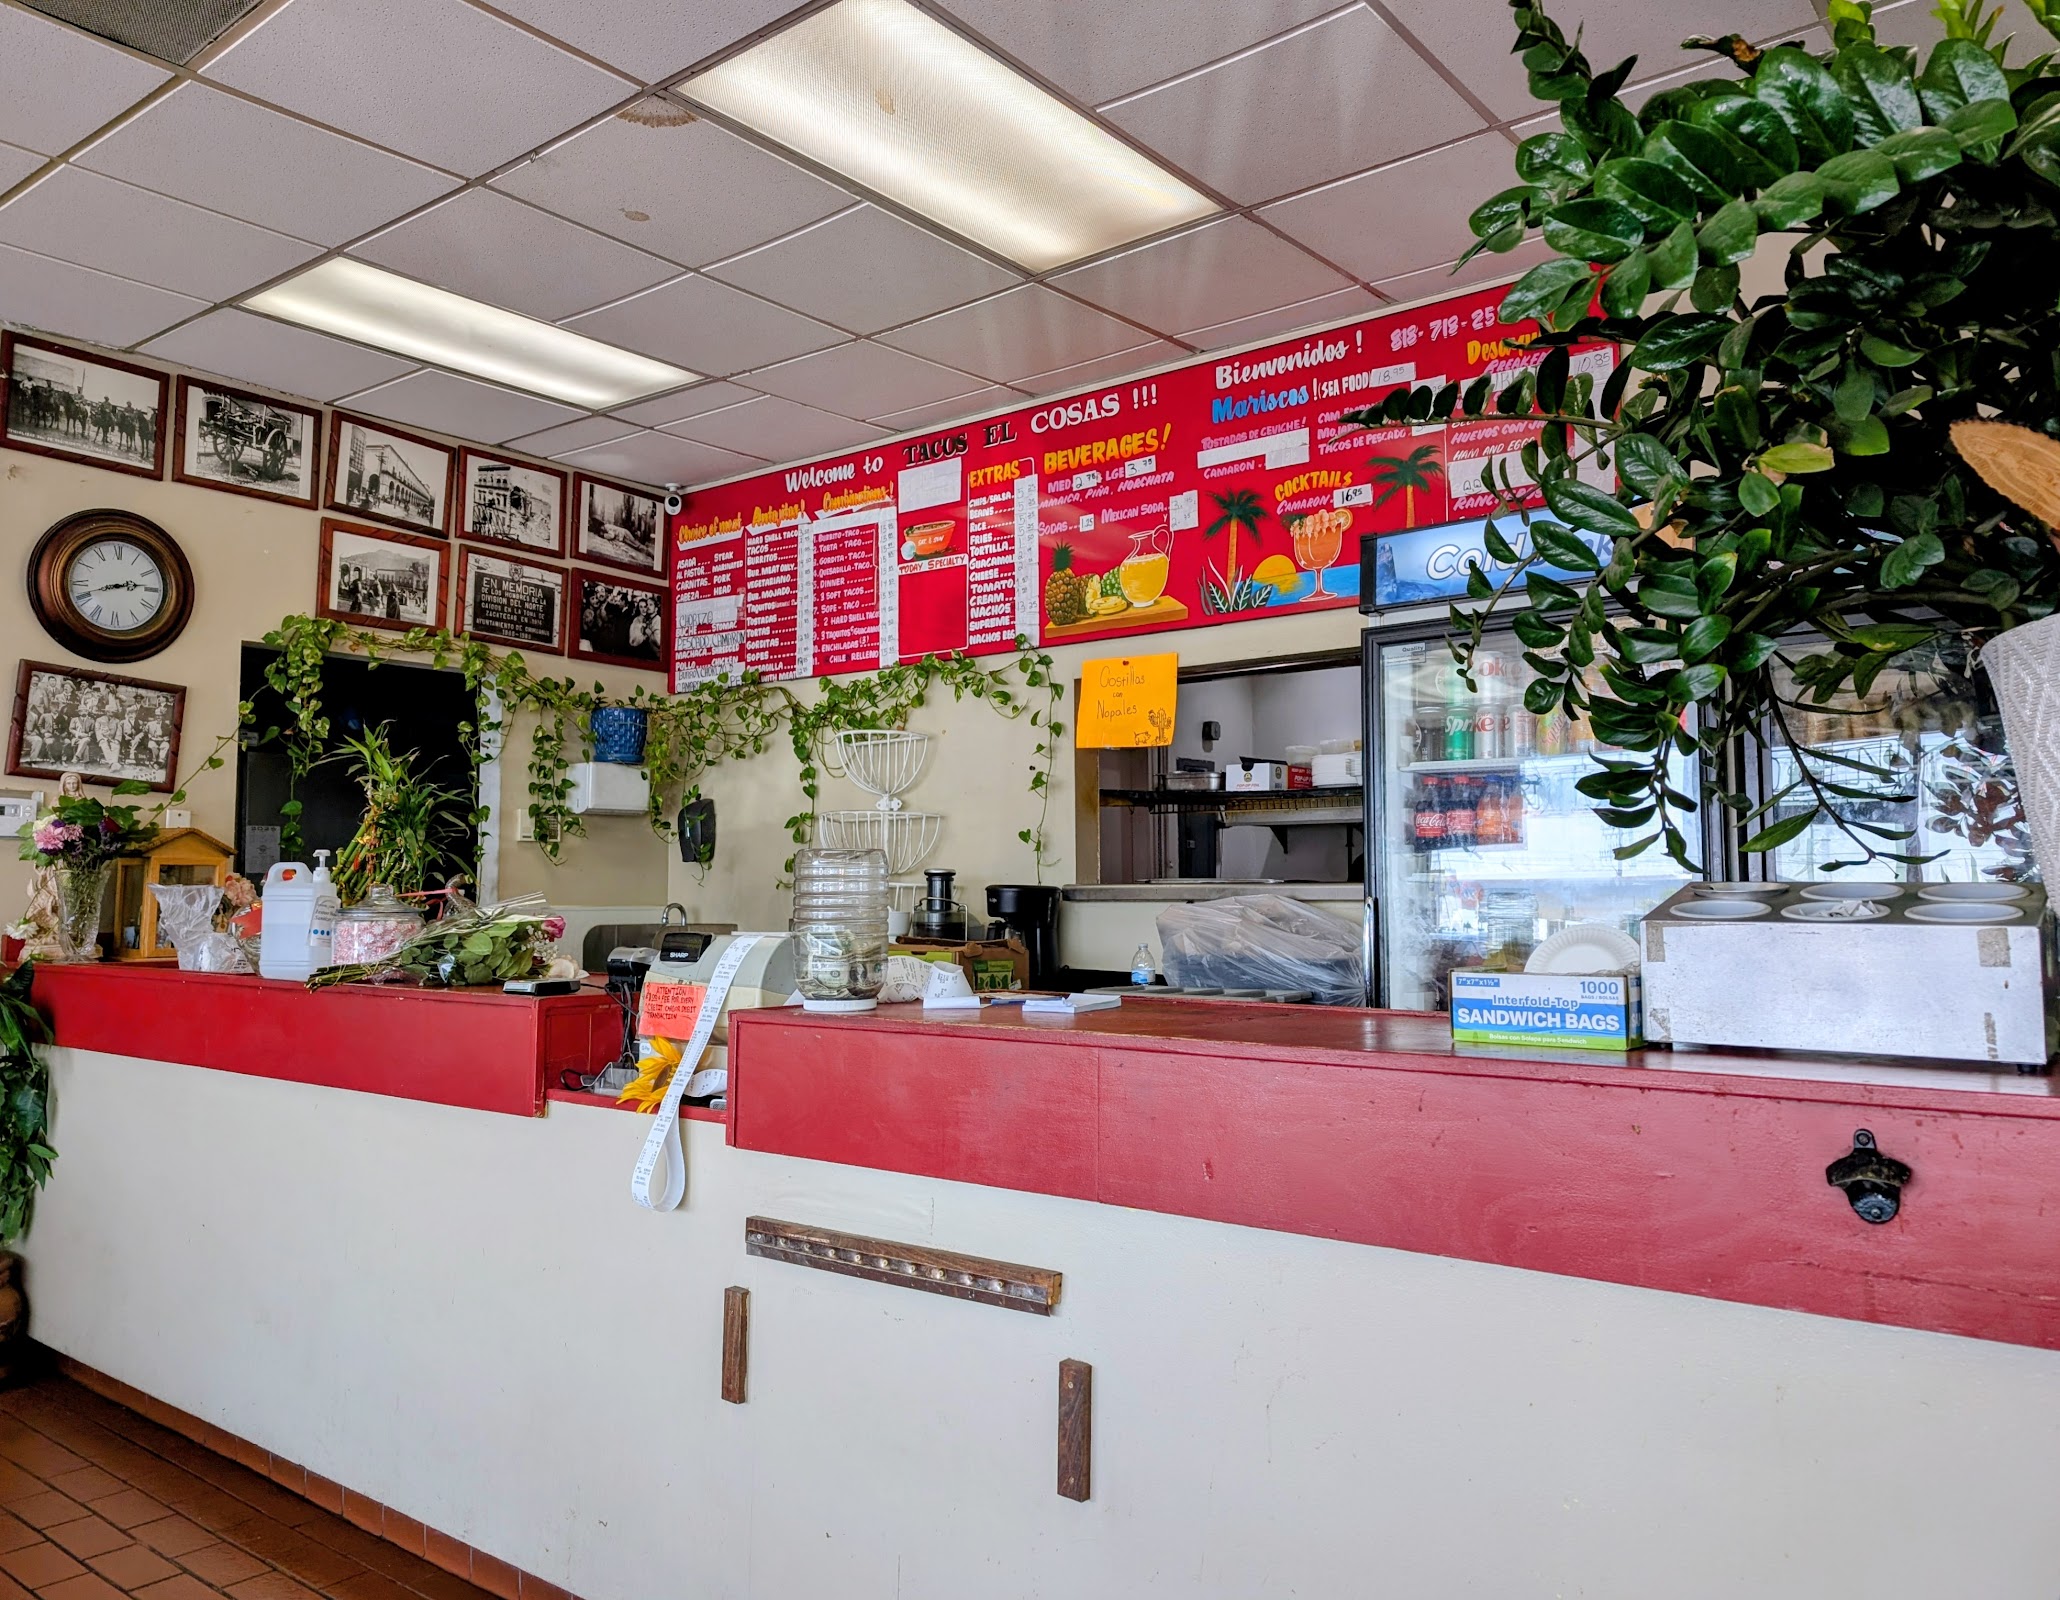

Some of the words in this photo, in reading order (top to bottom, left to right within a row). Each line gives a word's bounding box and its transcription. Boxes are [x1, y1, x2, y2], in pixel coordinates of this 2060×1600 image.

[1215, 340, 1349, 389] Bienvenidos
[1378, 366, 1405, 384] 18.95
[1212, 384, 1309, 424] Mariscos
[903, 432, 969, 467] TACOS
[983, 420, 1018, 448] EL
[1030, 392, 1120, 434] COSAS
[1132, 383, 1158, 410] !!!
[1451, 425, 1500, 445] HUEVOS
[1501, 420, 1527, 435] CON
[1201, 432, 1247, 450] TOSTADAS
[1249, 429, 1259, 439] DE
[1353, 435, 1364, 448] DE
[1366, 429, 1406, 445] PESCADO
[1044, 422, 1172, 474] BEVERAGES!
[1453, 447, 1479, 461] HAM
[1482, 443, 1504, 456] AND
[785, 463, 855, 493] Welcome
[863, 456, 883, 475] to
[969, 460, 1020, 488] EXTRAS
[1105, 466, 1125, 481] LGE
[1204, 459, 1255, 479] CAMARON
[1117, 470, 1175, 493] HORCHATA
[1274, 470, 1353, 502] COCKTAILS
[1341, 488, 1362, 505] 16.95
[1276, 494, 1330, 515] CAMARON
[970, 506, 994, 519] BEANS
[1101, 507, 1138, 524] MEXICAN
[679, 523, 707, 544] Choice
[709, 516, 719, 537] of
[718, 511, 742, 535] meat
[970, 522, 986, 533] RICE
[1038, 521, 1068, 536] SODAS
[747, 536, 763, 546] HARD
[765, 533, 782, 543] SHELL
[819, 543, 837, 553] TORTA
[844, 538, 862, 549] TACO
[970, 532, 992, 545] FRIES
[747, 544, 769, 556] TACOS
[970, 541, 1008, 557] TORTILLA
[1426, 532, 1528, 580] Cold
[677, 557, 696, 570] ASADA
[714, 551, 734, 562] STEAK
[747, 553, 778, 566] BURRITOS
[899, 562, 923, 574] TODAY
[928, 555, 966, 569] SPECIALTY
[676, 571, 683, 580] AL
[684, 566, 705, 578] PASTOR
[761, 564, 780, 575] MEAT
[970, 568, 999, 582] CHEESE
[483, 577, 497, 589] EN
[502, 580, 543, 598] MEMORIA
[676, 577, 708, 591] CARNITAS
[713, 573, 731, 584] PORK
[747, 574, 791, 589] VEGETARIANO
[820, 577, 845, 588] DINNER
[970, 579, 1013, 594] TOMATO
[676, 591, 700, 603] CABEZA
[713, 585, 731, 596] HEAD
[761, 586, 790, 599] MOJADO
[826, 590, 841, 600] SOFT
[843, 586, 864, 598] TACOS
[970, 593, 1004, 606] CREAM
[481, 594, 508, 605] DIVISION
[510, 599, 522, 608] DEL
[525, 602, 544, 612] NORTE
[821, 604, 837, 614] SOPE
[843, 600, 859, 610] TACO
[486, 610, 517, 621] ZACATECAS
[830, 614, 847, 625] HARD
[848, 612, 865, 623] SHELL
[970, 603, 1011, 619] NACHOS
[746, 614, 777, 626] TOSTADAS
[969, 615, 1010, 631] SUPREME
[676, 626, 697, 638] BUCHE
[746, 626, 771, 638] TORTAS
[970, 631, 1001, 645] NACHOS
[746, 638, 779, 650] GORDITAS
[822, 640, 858, 652] ENCHILADAS
[675, 649, 707, 661] MACHACA
[746, 651, 769, 662] SOPES
[829, 654, 846, 663] CHILE
[851, 650, 879, 660] RELLENO
[676, 661, 696, 672] POLLO
[761, 673, 777, 682] WITH
[779, 671, 797, 681] MEAT
[1100, 665, 1145, 688] Costillas
[1097, 700, 1137, 722] Nopales
[670, 951, 689, 959] SHARP
[1580, 981, 1619, 995] 1000
[1493, 994, 1580, 1012] Interfold-Top
[1458, 1008, 1561, 1028] SANDWICH
[1565, 1013, 1620, 1031] BAGS
[1489, 1032, 1509, 1041] Bolsas
[1521, 1034, 1542, 1044] Solapa
[1542, 1037, 1557, 1045] para
[1557, 1036, 1588, 1045] Sandwich
